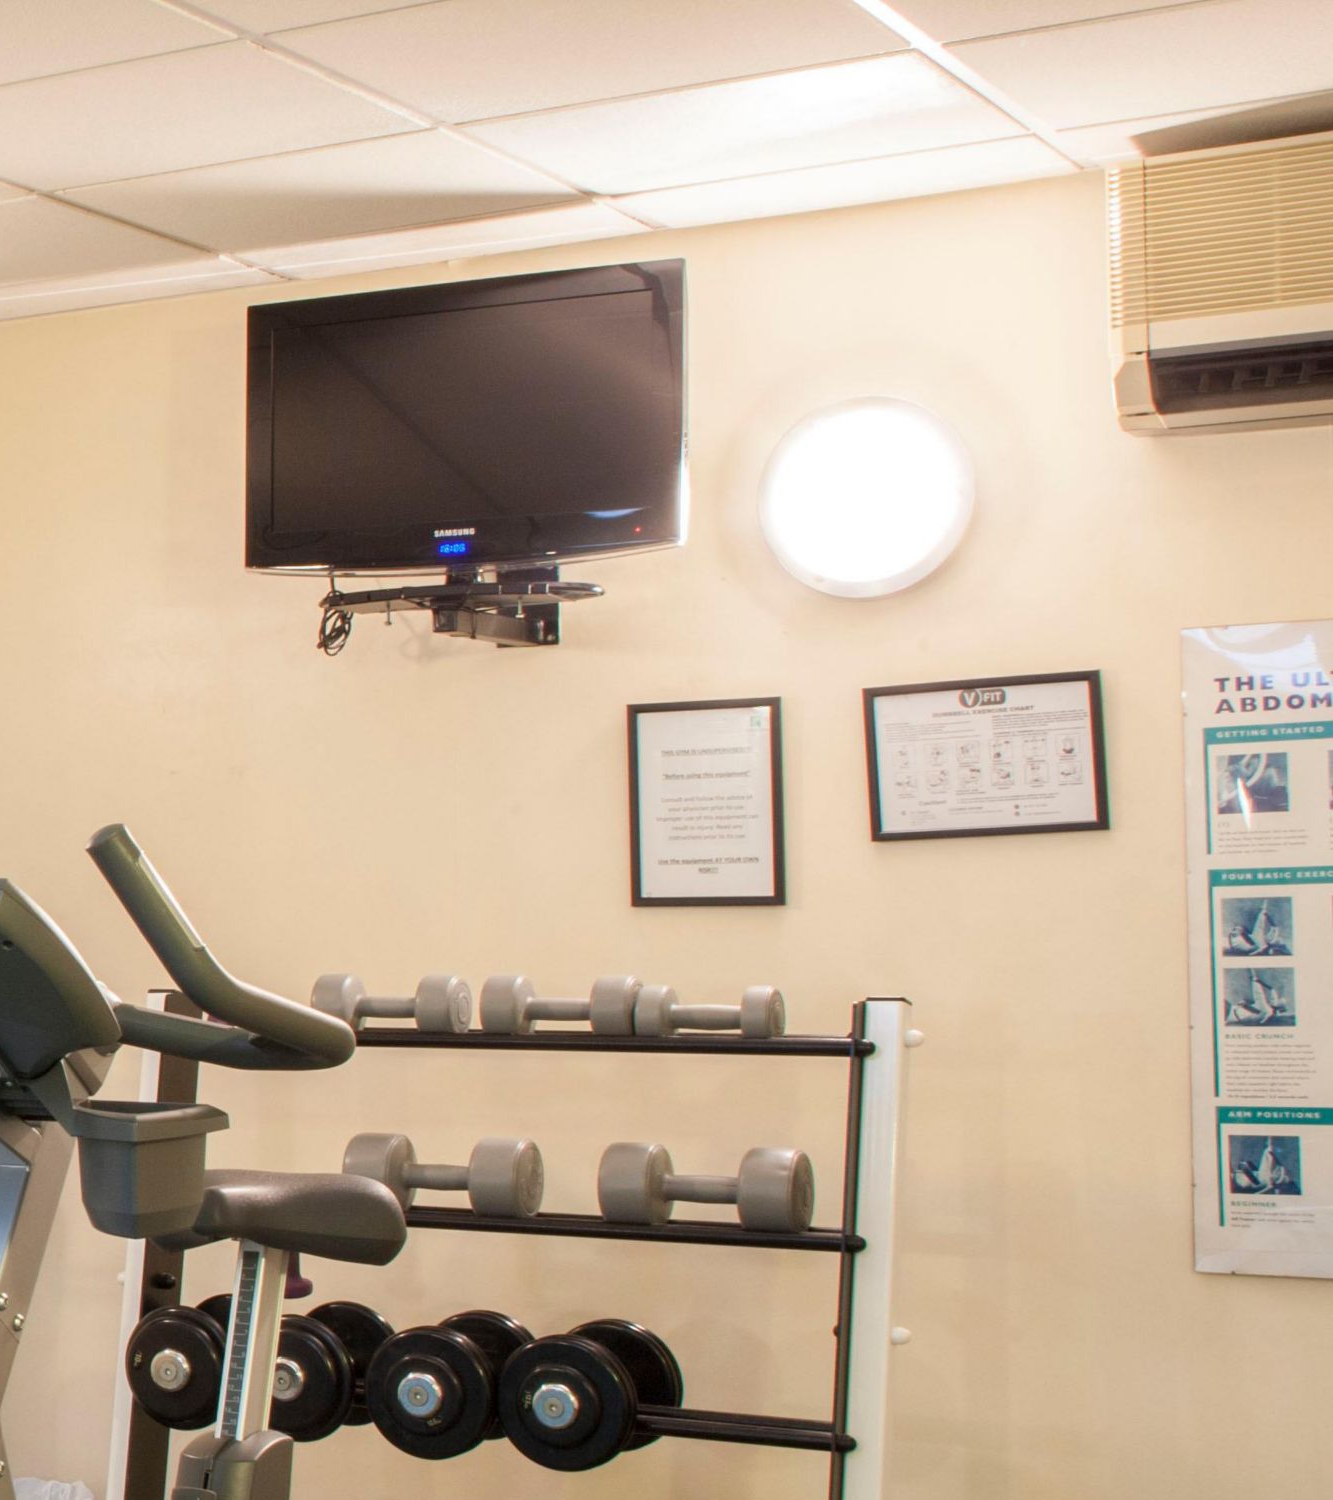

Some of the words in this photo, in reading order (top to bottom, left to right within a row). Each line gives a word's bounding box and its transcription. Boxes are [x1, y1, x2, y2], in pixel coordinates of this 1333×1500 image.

[434, 528, 475, 537] SAMSUNG
[1214, 674, 1275, 692] THE
[1291, 671, 1333, 688] UL
[983, 690, 1003, 703] FIT
[1215, 729, 1269, 739] GETTING
[1271, 726, 1326, 736] STARTED
[1221, 871, 1252, 881] YOUR
[1256, 870, 1292, 880] BASIC
[1227, 1111, 1252, 1119] ARM
[1256, 1111, 1322, 1120] POSITIONS
